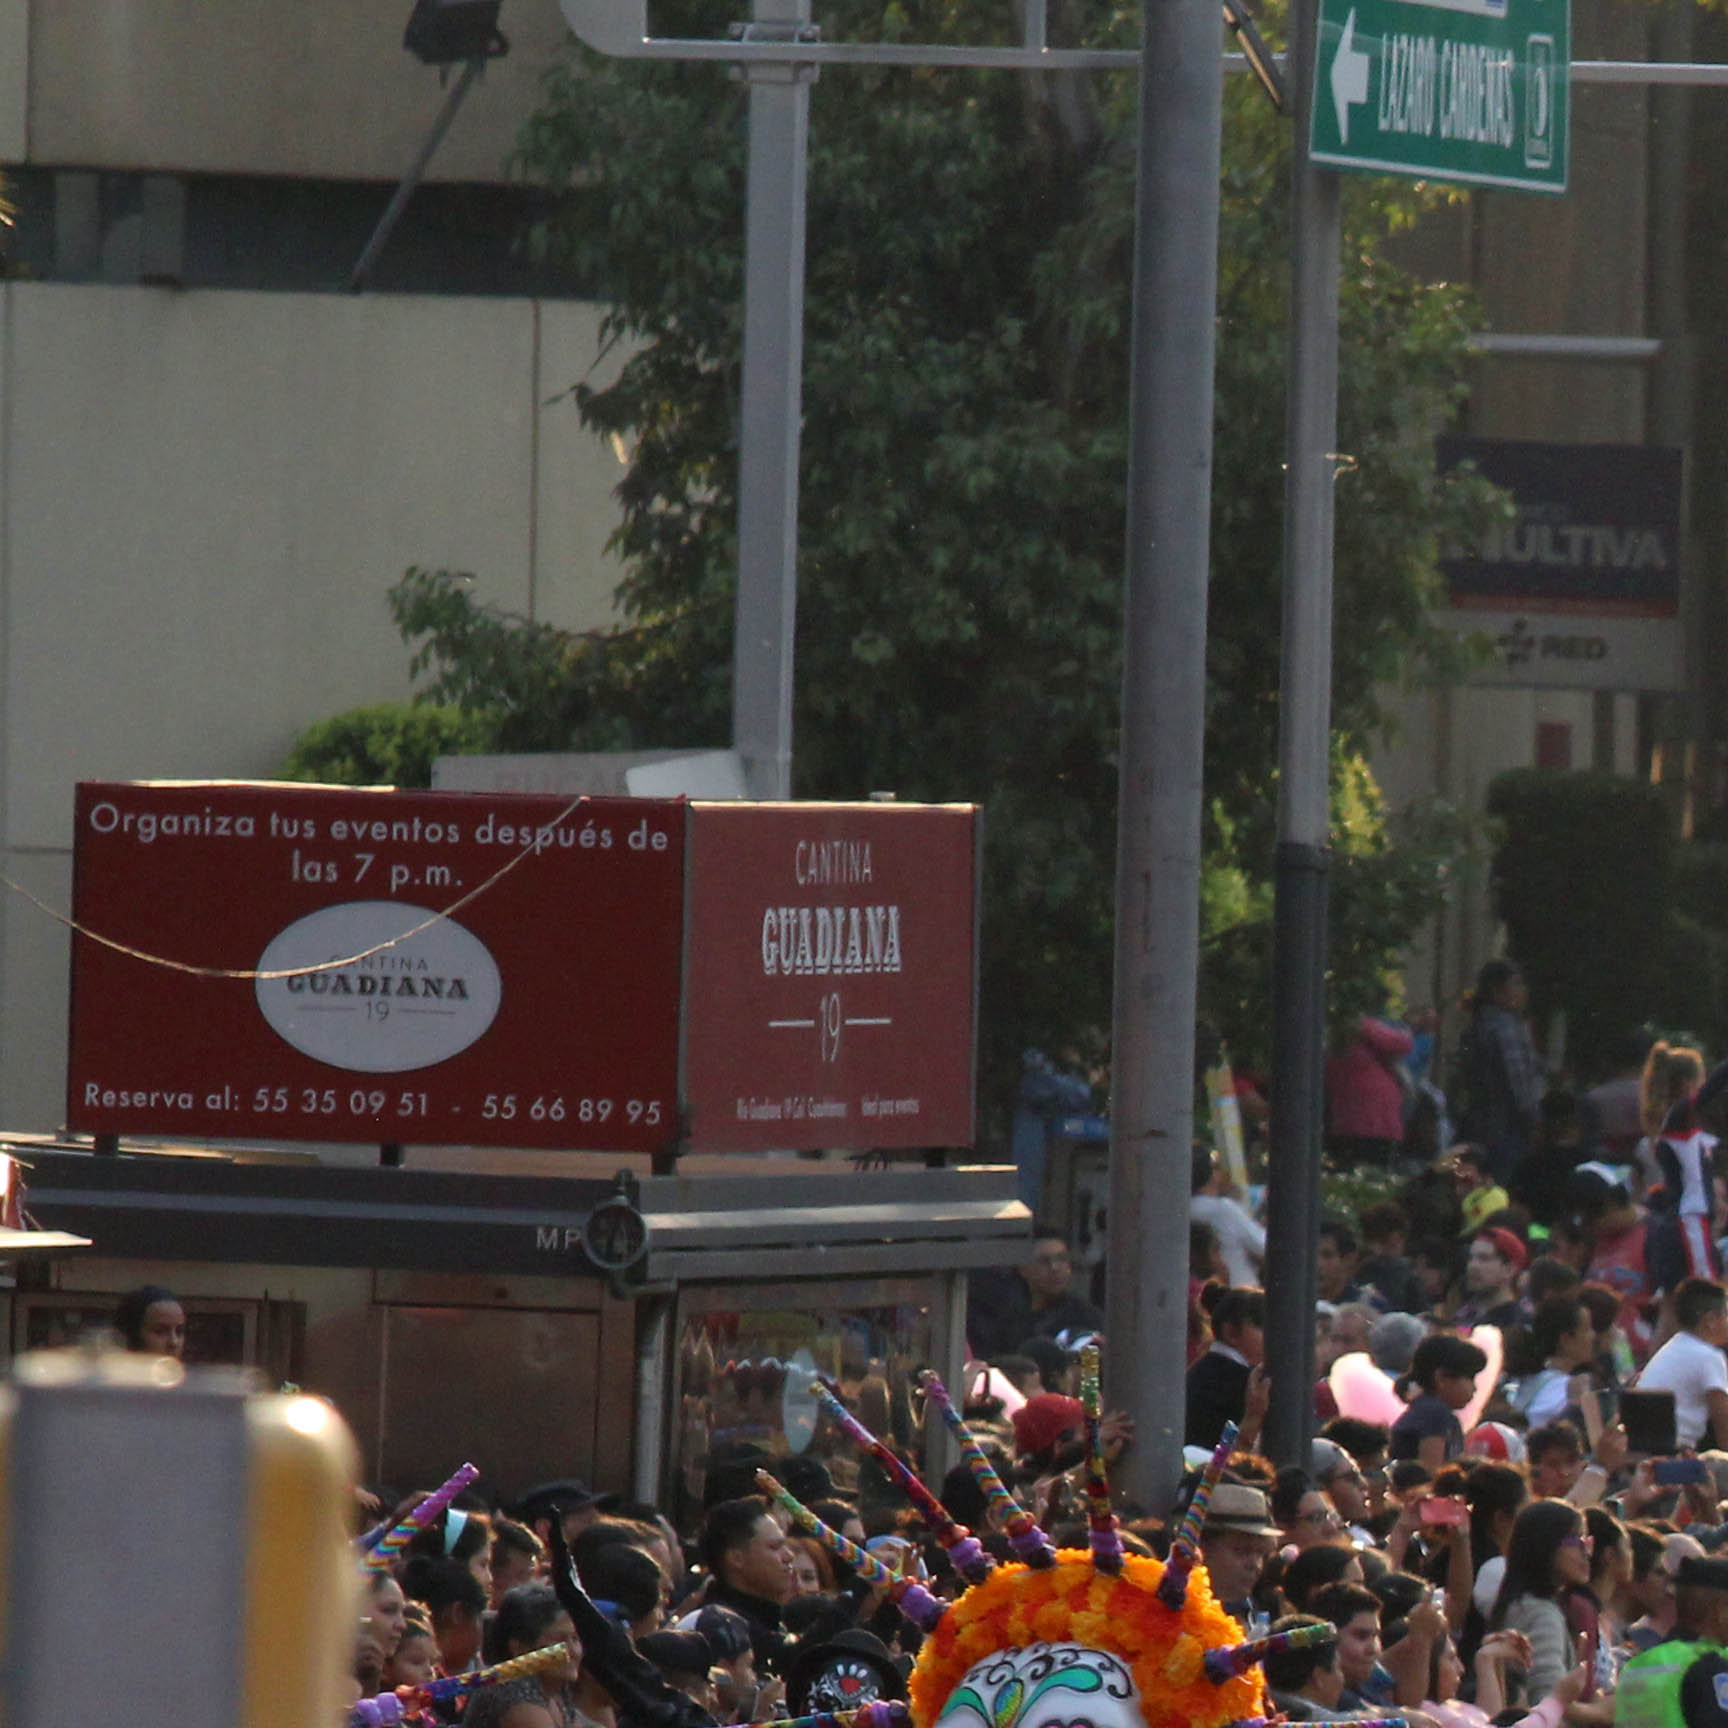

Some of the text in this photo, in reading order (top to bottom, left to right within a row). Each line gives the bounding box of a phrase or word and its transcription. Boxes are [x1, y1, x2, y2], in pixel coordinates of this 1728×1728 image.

[1378, 33, 1514, 148] LAZARO CARDENAS
[90, 803, 669, 855] Organiza tus eventos después de
[292, 849, 463, 892] las 7 p.m.
[795, 840, 872, 884] CANTINA
[762, 905, 901, 975] GUADIANA
[286, 973, 469, 1000] GUADIANA
[366, 1001, 391, 1022] 19
[820, 992, 841, 1062] 19
[84, 1083, 193, 1110] Reserva
[205, 1085, 240, 1111] al:
[253, 1088, 289, 1113] 55
[302, 1089, 337, 1115] 35
[349, 1090, 386, 1117] 09
[397, 1092, 429, 1117] 51
[482, 1094, 517, 1119] 55
[530, 1096, 565, 1121] 66
[579, 1098, 614, 1123] 89
[626, 1099, 662, 1125] 95
